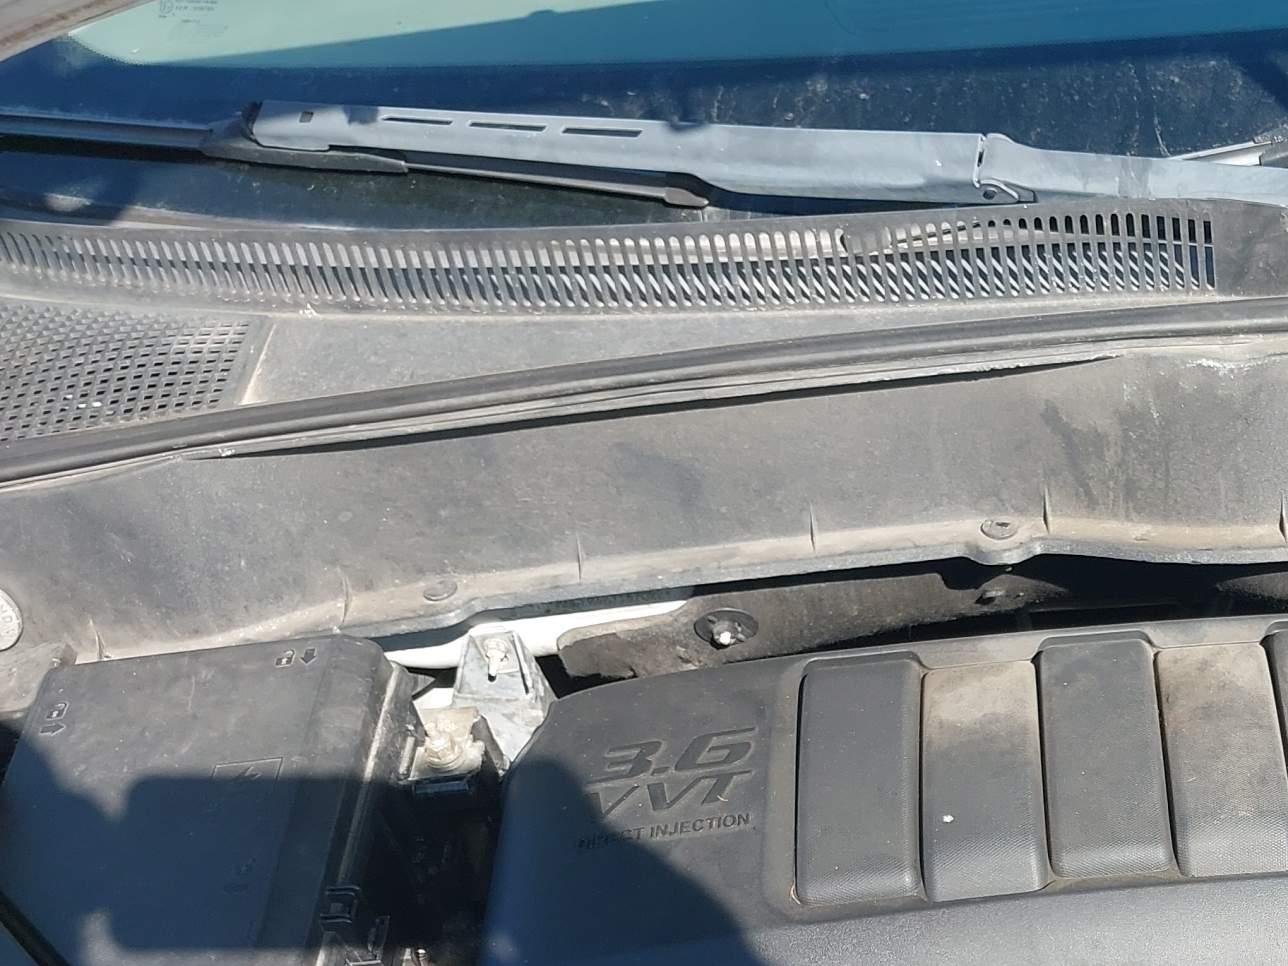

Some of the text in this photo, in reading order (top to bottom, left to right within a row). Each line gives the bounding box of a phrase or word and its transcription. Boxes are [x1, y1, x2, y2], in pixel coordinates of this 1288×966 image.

[587, 727, 757, 783] 3.6
[588, 769, 753, 818] VVT
[650, 812, 751, 840] INJECTION
